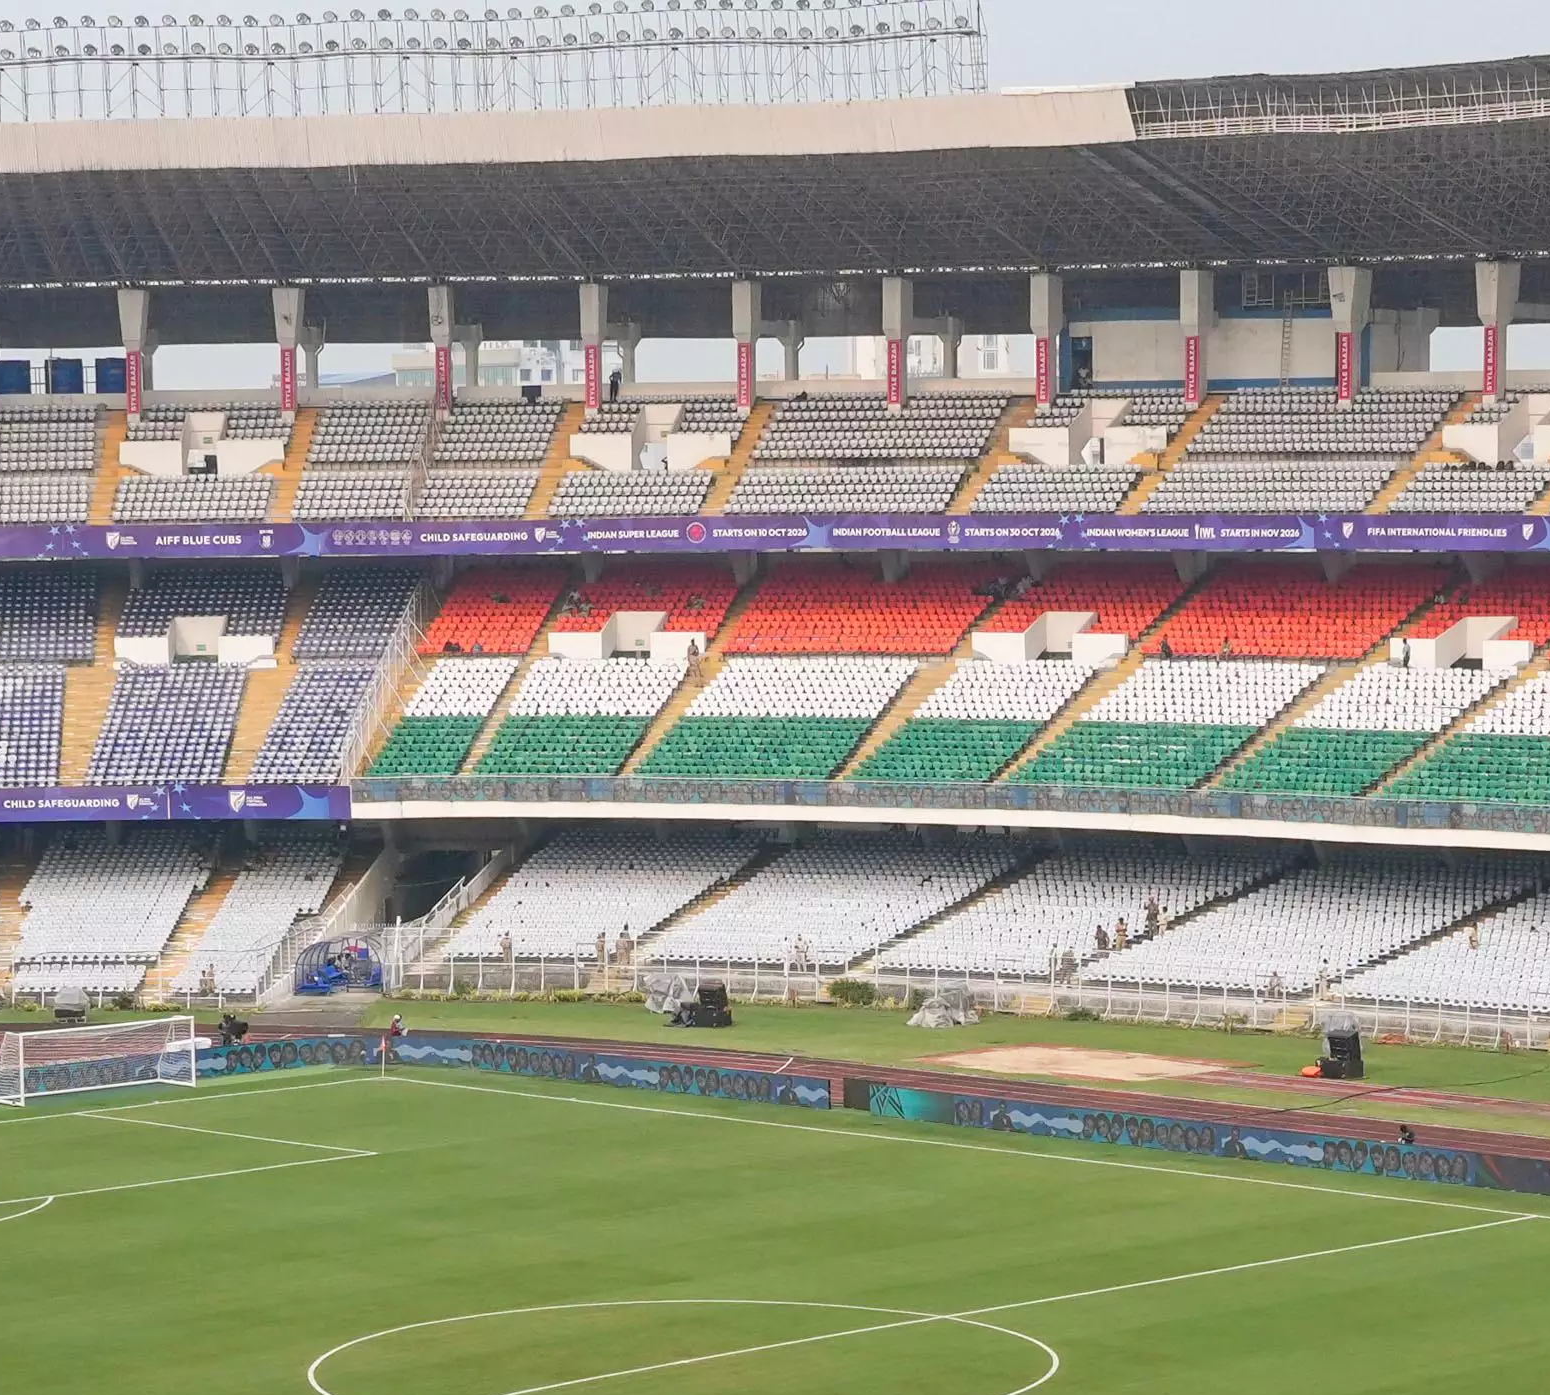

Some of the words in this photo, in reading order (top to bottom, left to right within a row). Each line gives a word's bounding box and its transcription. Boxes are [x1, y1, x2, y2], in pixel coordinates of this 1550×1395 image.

[586, 530, 617, 539] INDIAN
[618, 530, 644, 539] SUPER
[645, 529, 679, 538] LEAGUE
[712, 528, 743, 537] STARTS
[743, 528, 757, 537] ON
[758, 528, 767, 537] 10
[768, 528, 786, 537] OCT
[787, 528, 807, 536] 2026
[832, 528, 862, 536] INDIAN
[862, 527, 906, 536] FOOTBALL
[907, 528, 940, 536] LEAGUE
[964, 528, 994, 536] STARTS
[995, 528, 1008, 536] ON
[1009, 528, 1020, 536] 30
[1020, 527, 1038, 536] OCT
[1039, 527, 1061, 537] 2026
[1086, 528, 1115, 536] INDIAN
[1116, 528, 1155, 537] WOMEN'S
[1156, 528, 1188, 537] LEAGUE
[1201, 527, 1215, 539] IWL
[1220, 528, 1250, 537] STARTS
[1250, 528, 1259, 537] IN
[1260, 528, 1279, 537] NOV
[1280, 528, 1299, 537] 2026
[1367, 527, 1385, 536] FIFA
[1387, 527, 1456, 536] INTERNATIONAL
[1457, 528, 1506, 537] FRIENDLIES
[155, 535, 180, 545] AIFF
[182, 535, 210, 545] BLUE
[212, 535, 241, 544] CUBS
[420, 533, 450, 542] CHILD
[452, 532, 528, 541] SAFEGUARDING
[3, 799, 35, 808] CHILD
[37, 798, 119, 808] SAFEGUARDING
